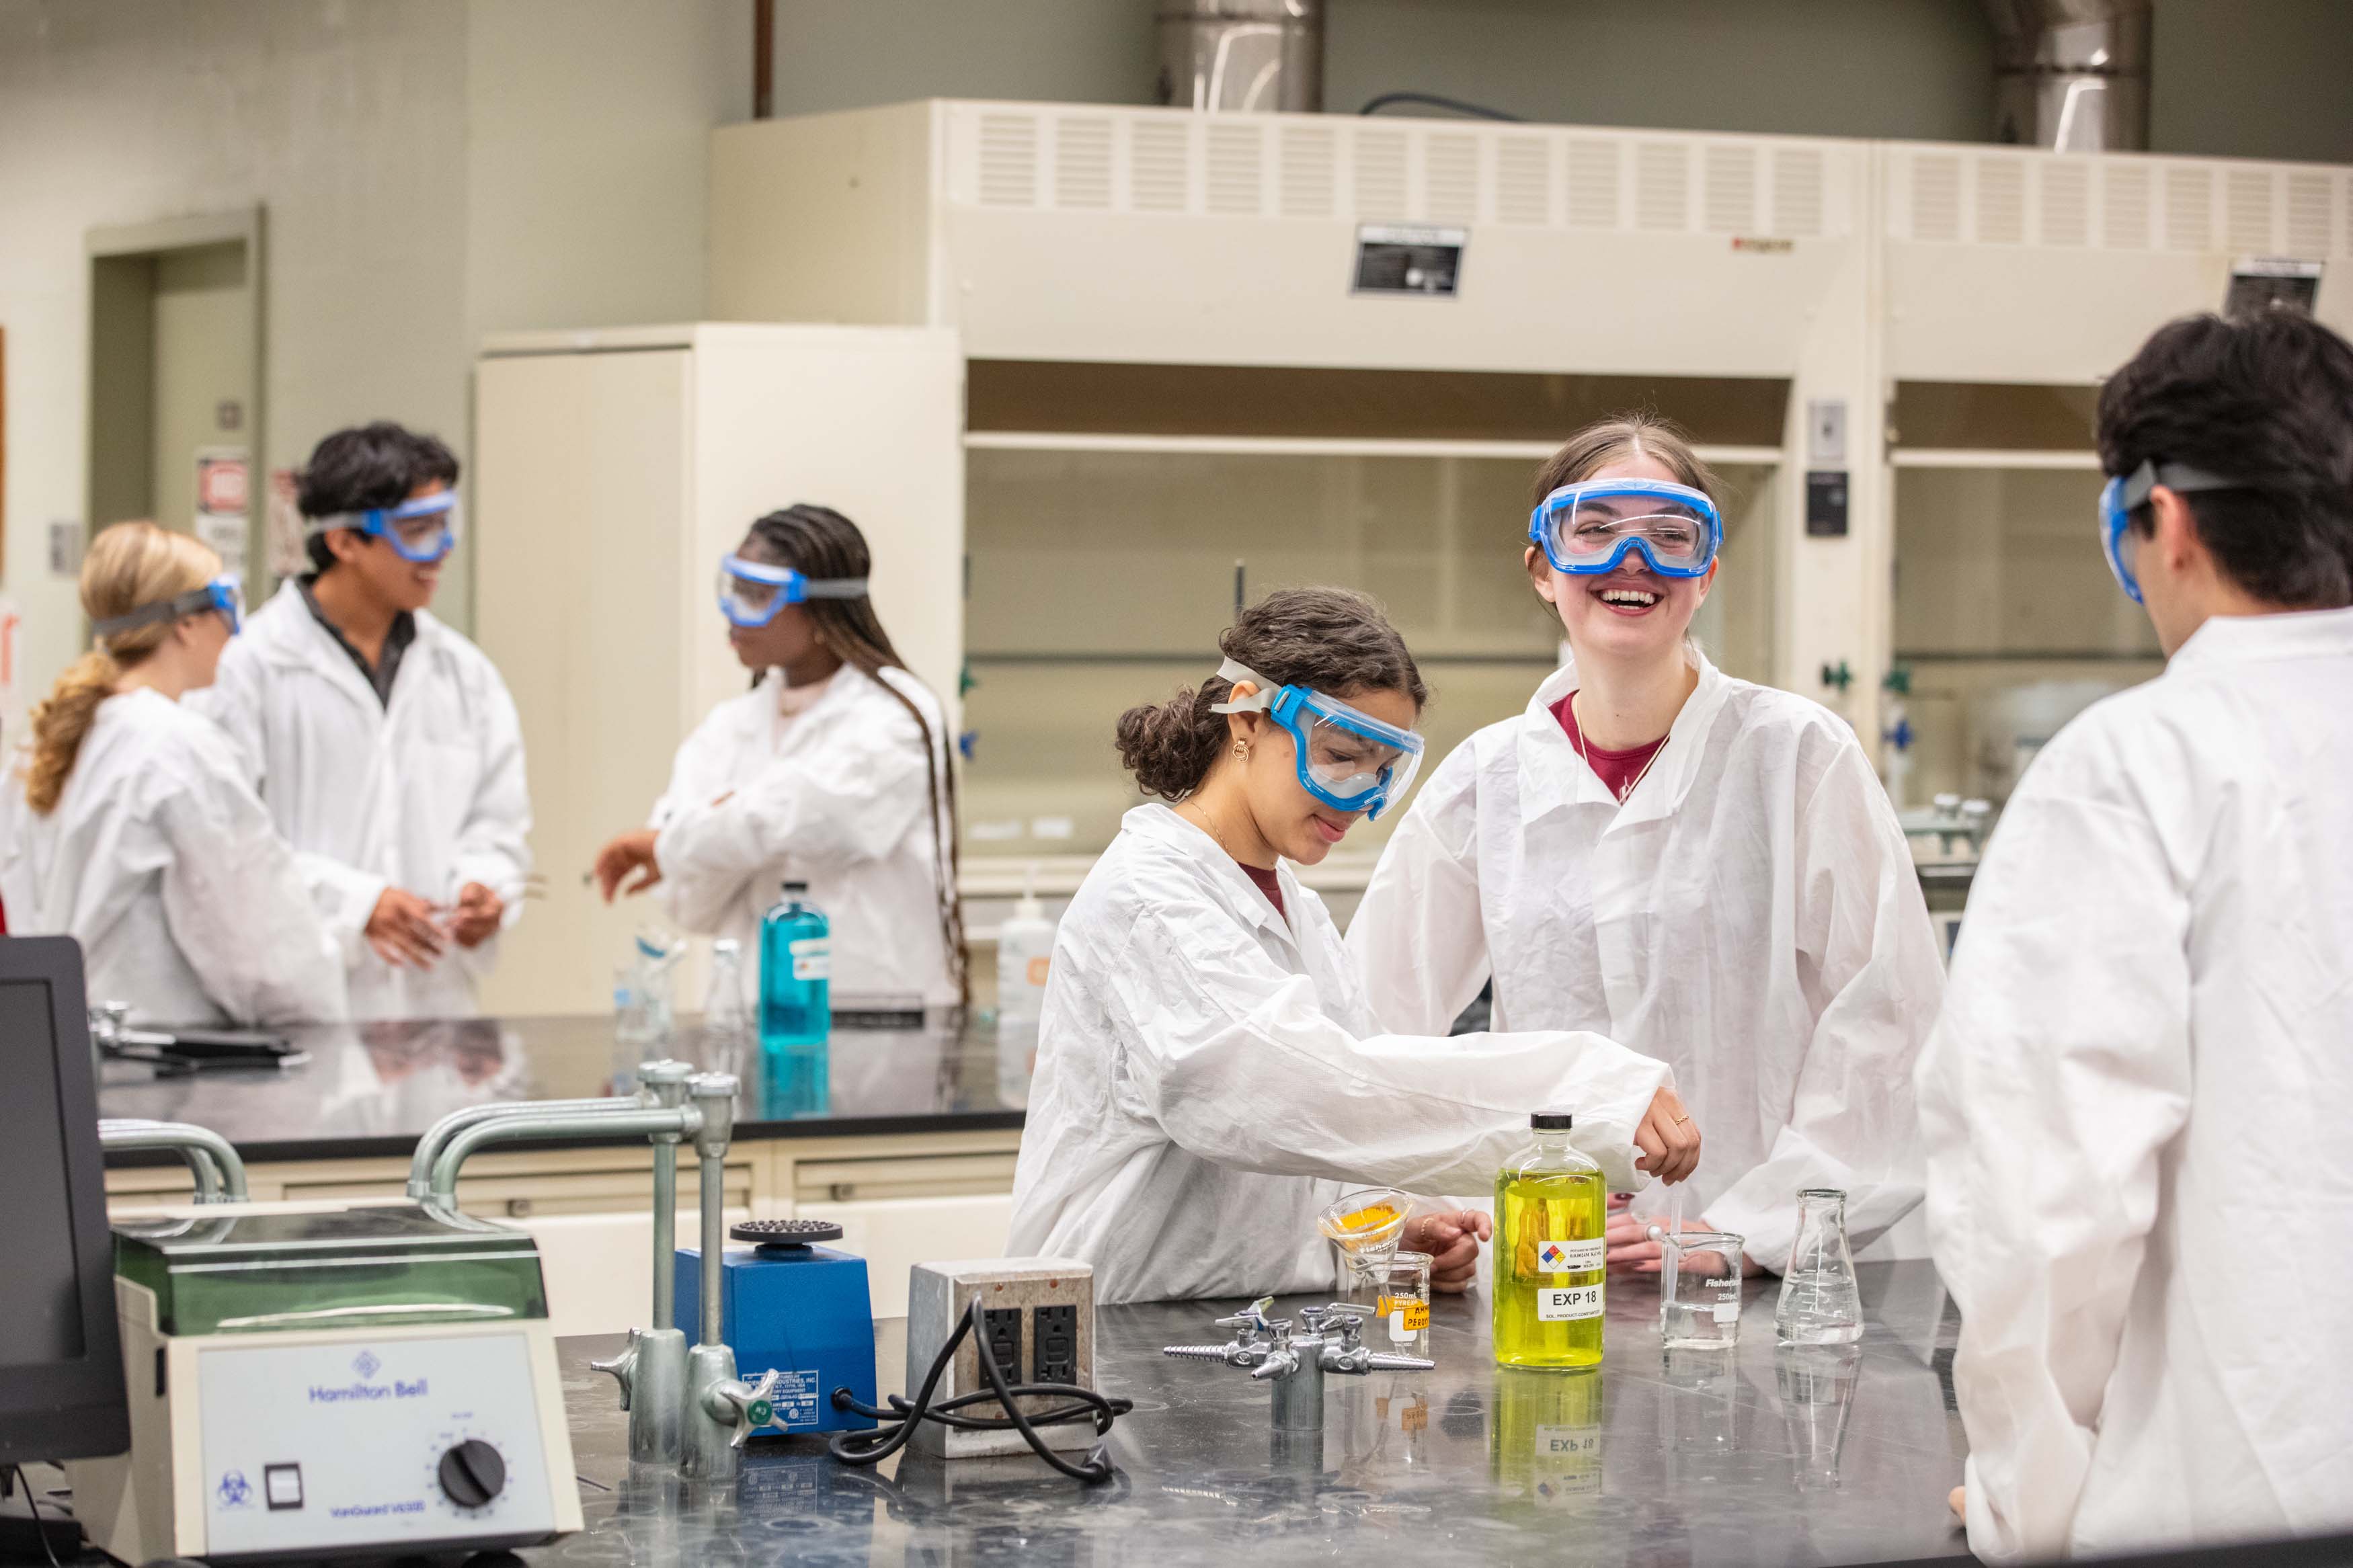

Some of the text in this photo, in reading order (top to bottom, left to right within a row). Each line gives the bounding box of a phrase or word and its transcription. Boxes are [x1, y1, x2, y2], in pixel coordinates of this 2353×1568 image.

[1553, 1291, 1597, 1305] EXP 18
[309, 1378, 428, 1403] Hamilton Bell
